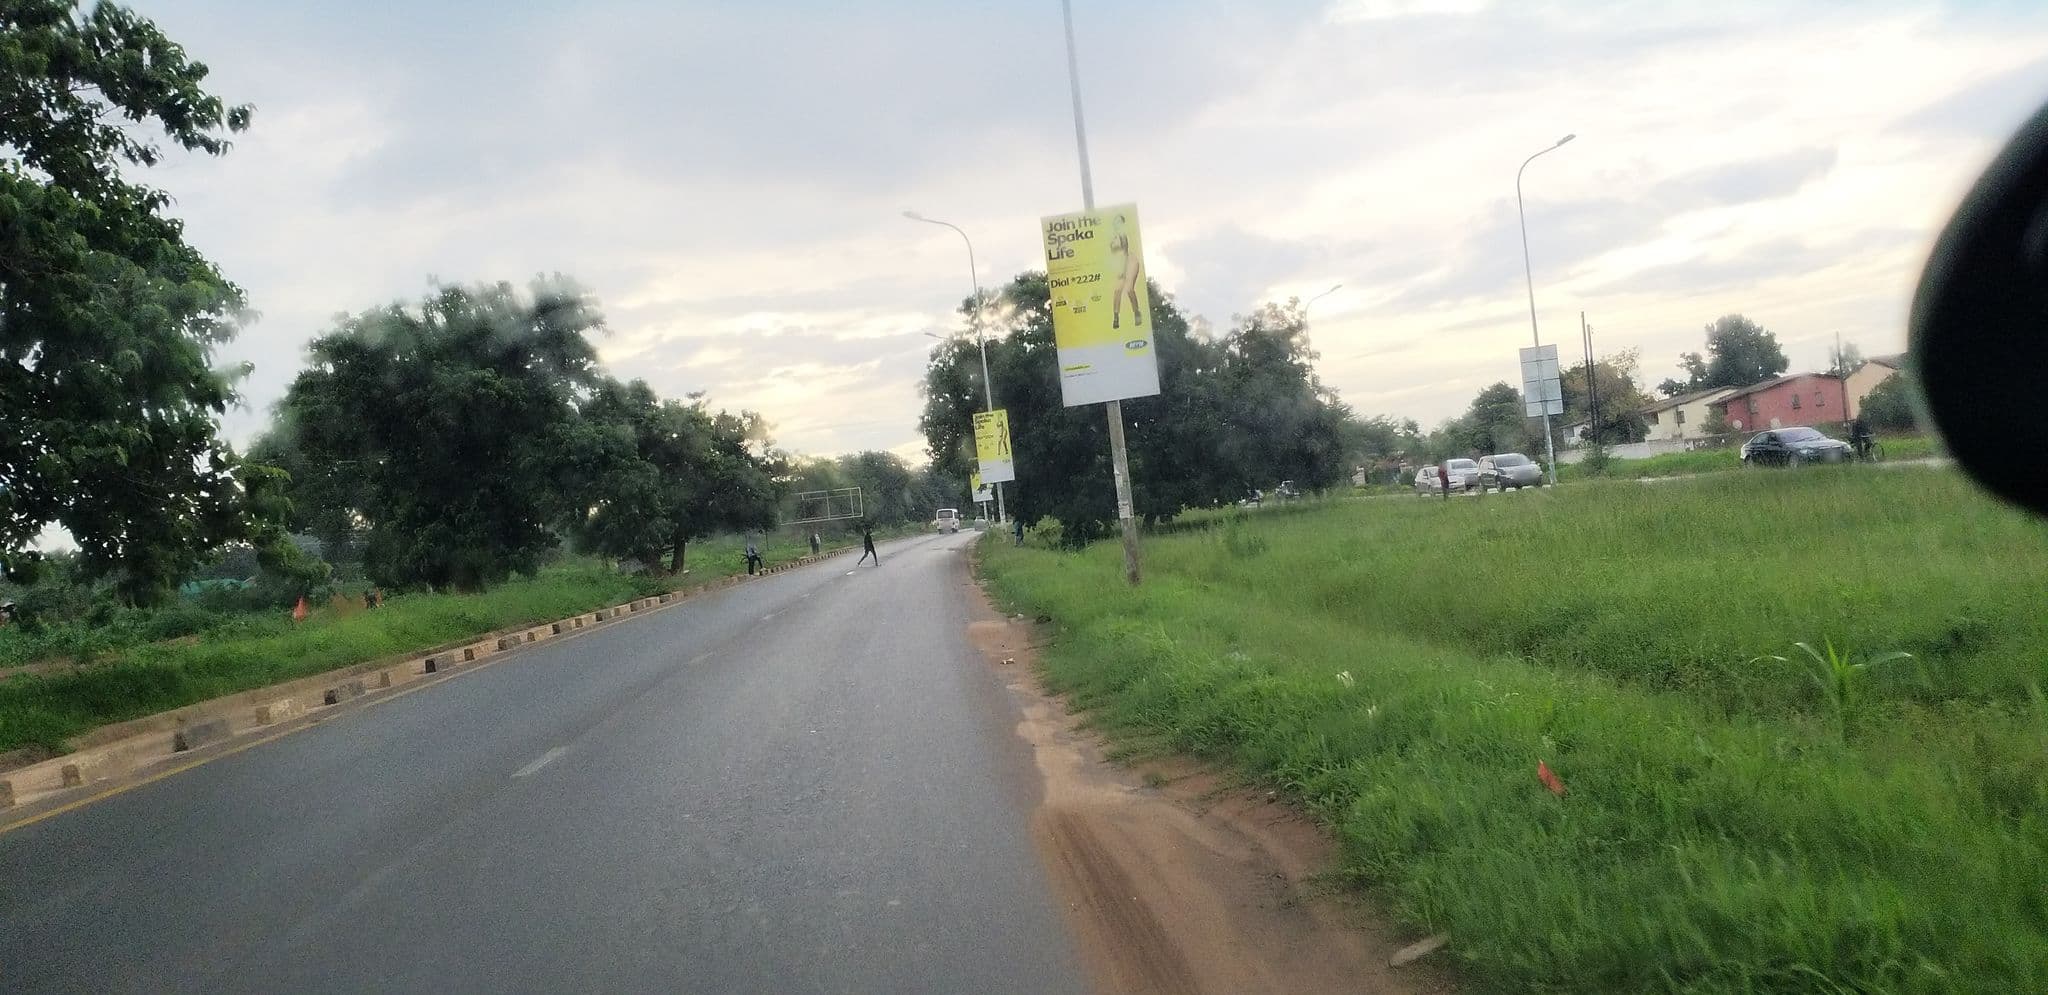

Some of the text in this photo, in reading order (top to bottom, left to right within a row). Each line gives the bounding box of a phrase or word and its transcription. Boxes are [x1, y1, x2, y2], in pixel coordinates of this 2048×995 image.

[1046, 216, 1102, 233] Join the
[1047, 229, 1094, 249] Spaka
[1048, 248, 1075, 261] Life
[1050, 277, 1070, 289] Dial
